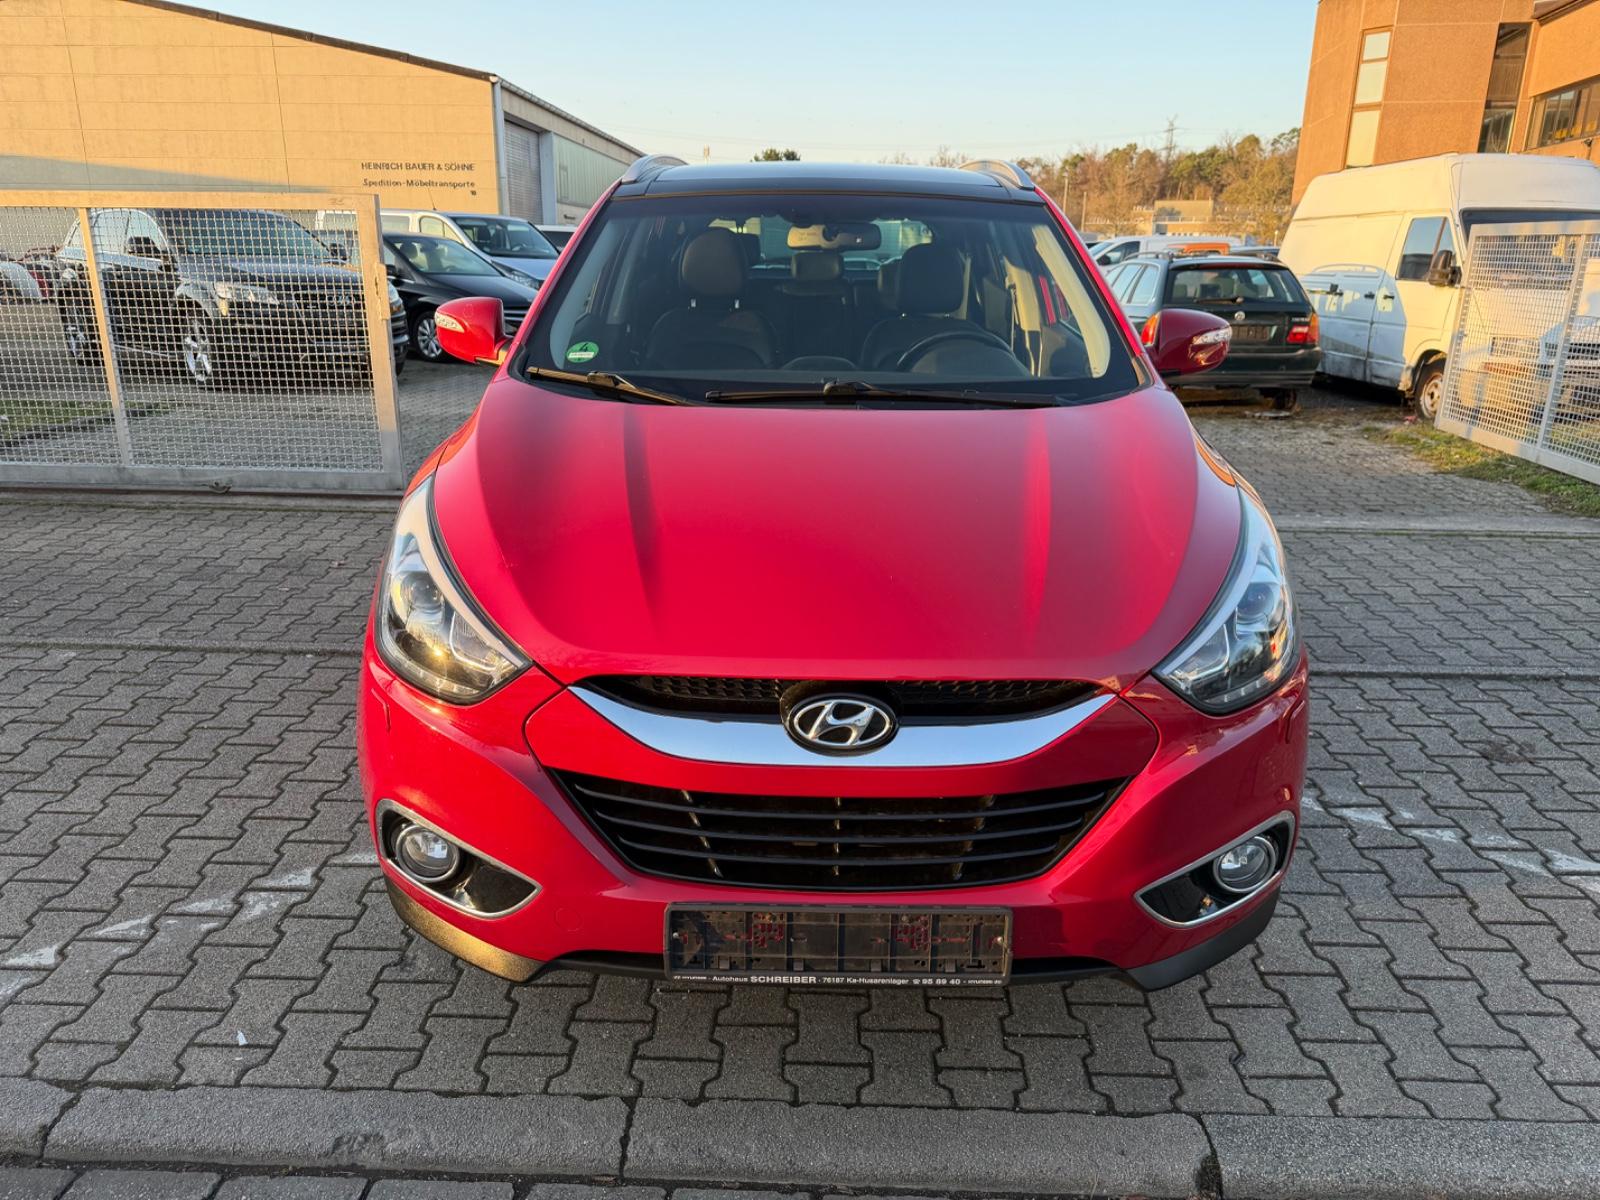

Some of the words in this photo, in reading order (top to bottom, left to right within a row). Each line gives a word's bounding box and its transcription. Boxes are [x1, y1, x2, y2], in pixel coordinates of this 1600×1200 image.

[361, 162, 403, 171] HEINRICH
[405, 162, 435, 171] BAUER
[436, 163, 443, 171] &
[444, 161, 475, 171] SÖHNE
[750, 975, 817, 984] SCHREIBER
